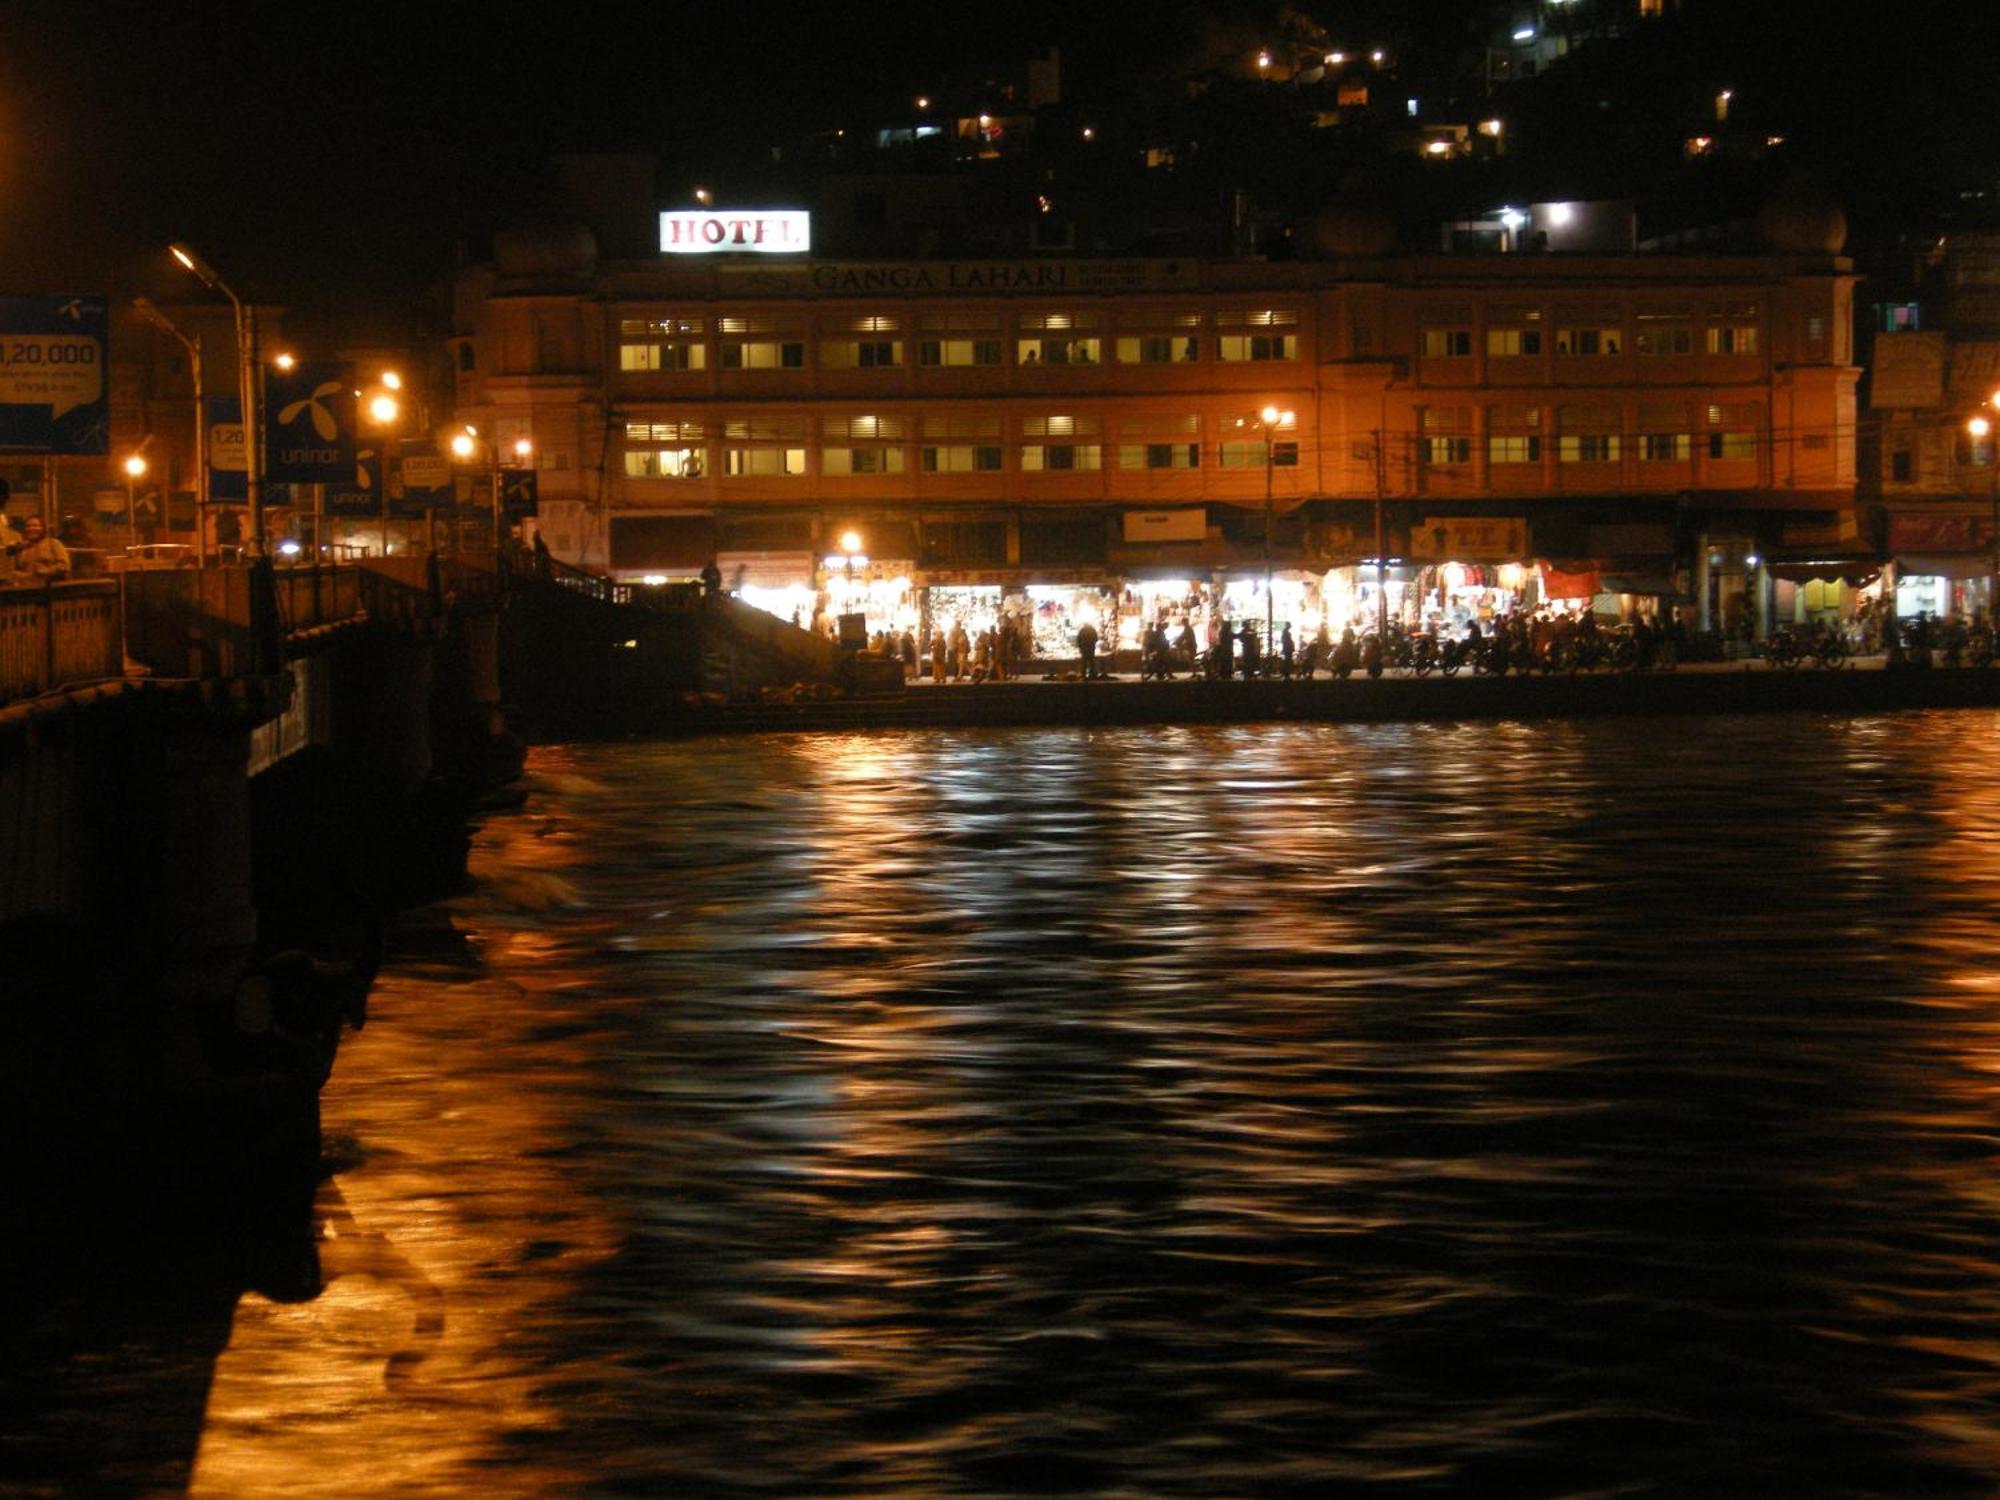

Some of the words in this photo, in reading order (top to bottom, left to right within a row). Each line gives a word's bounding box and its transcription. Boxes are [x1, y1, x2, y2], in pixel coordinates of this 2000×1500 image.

[670, 218, 799, 245] HOTEL
[813, 265, 933, 289] GANGA
[949, 263, 1065, 288] LAHARI
[279, 447, 339, 464] uninor
